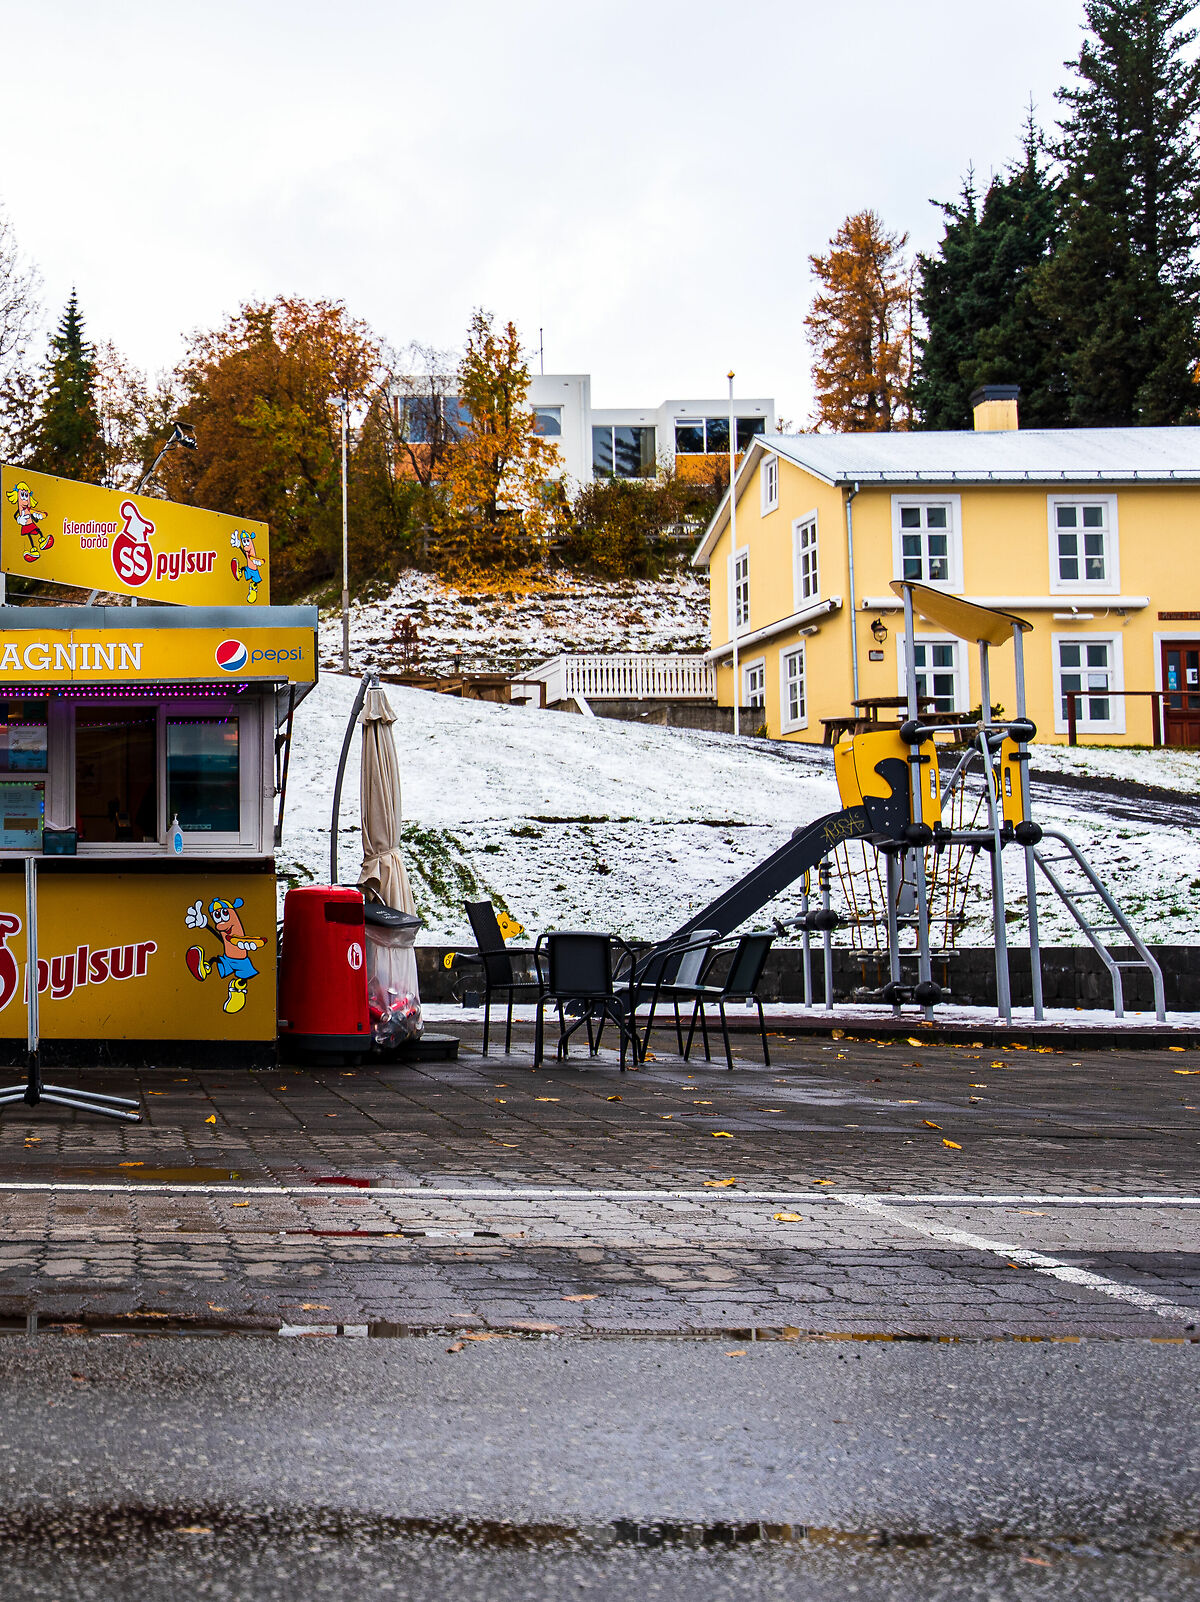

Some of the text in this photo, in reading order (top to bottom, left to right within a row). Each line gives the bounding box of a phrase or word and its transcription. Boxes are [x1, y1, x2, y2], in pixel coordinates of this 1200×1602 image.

[63, 519, 117, 536] Íslendingar
[80, 535, 108, 549] borða
[119, 546, 217, 581] SS pylsur
[251, 646, 303, 664] pepsi
[23, 940, 158, 1004] pylsur
